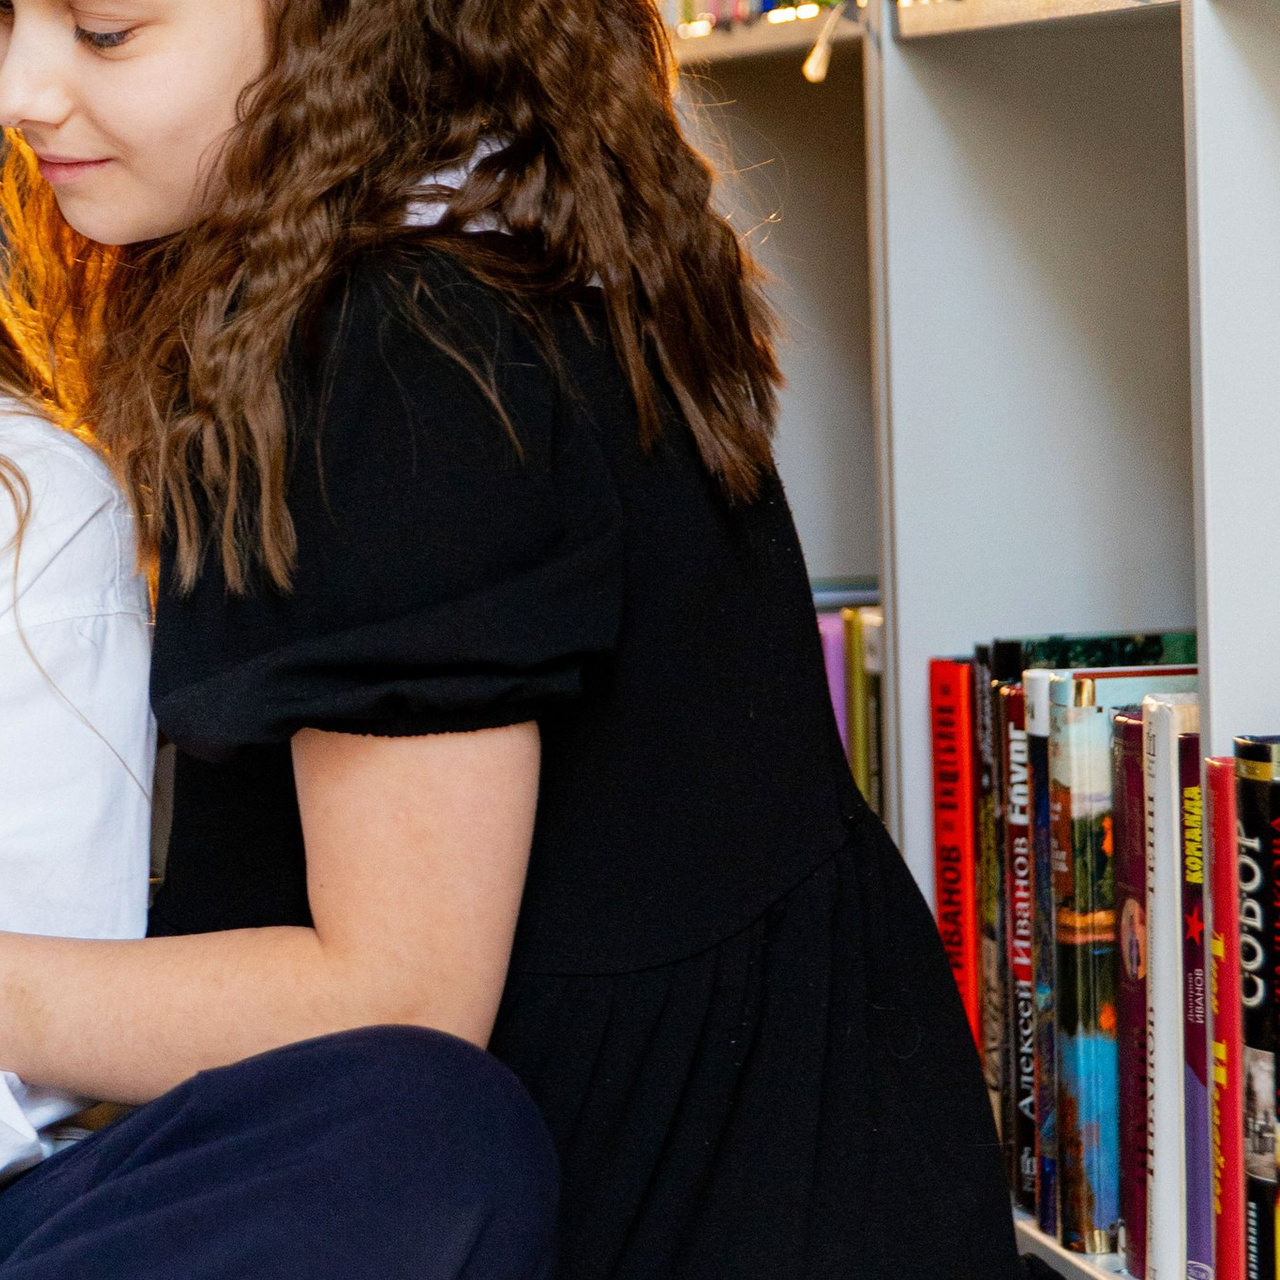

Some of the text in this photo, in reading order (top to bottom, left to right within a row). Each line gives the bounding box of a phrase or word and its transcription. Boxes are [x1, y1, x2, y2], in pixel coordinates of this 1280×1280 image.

[1183, 785, 1203, 884] КОМАНДА
[1013, 836, 1032, 966] Иванов
[1016, 980, 1036, 1121] Алексей
[1193, 967, 1205, 1024] ИВАНОВ
